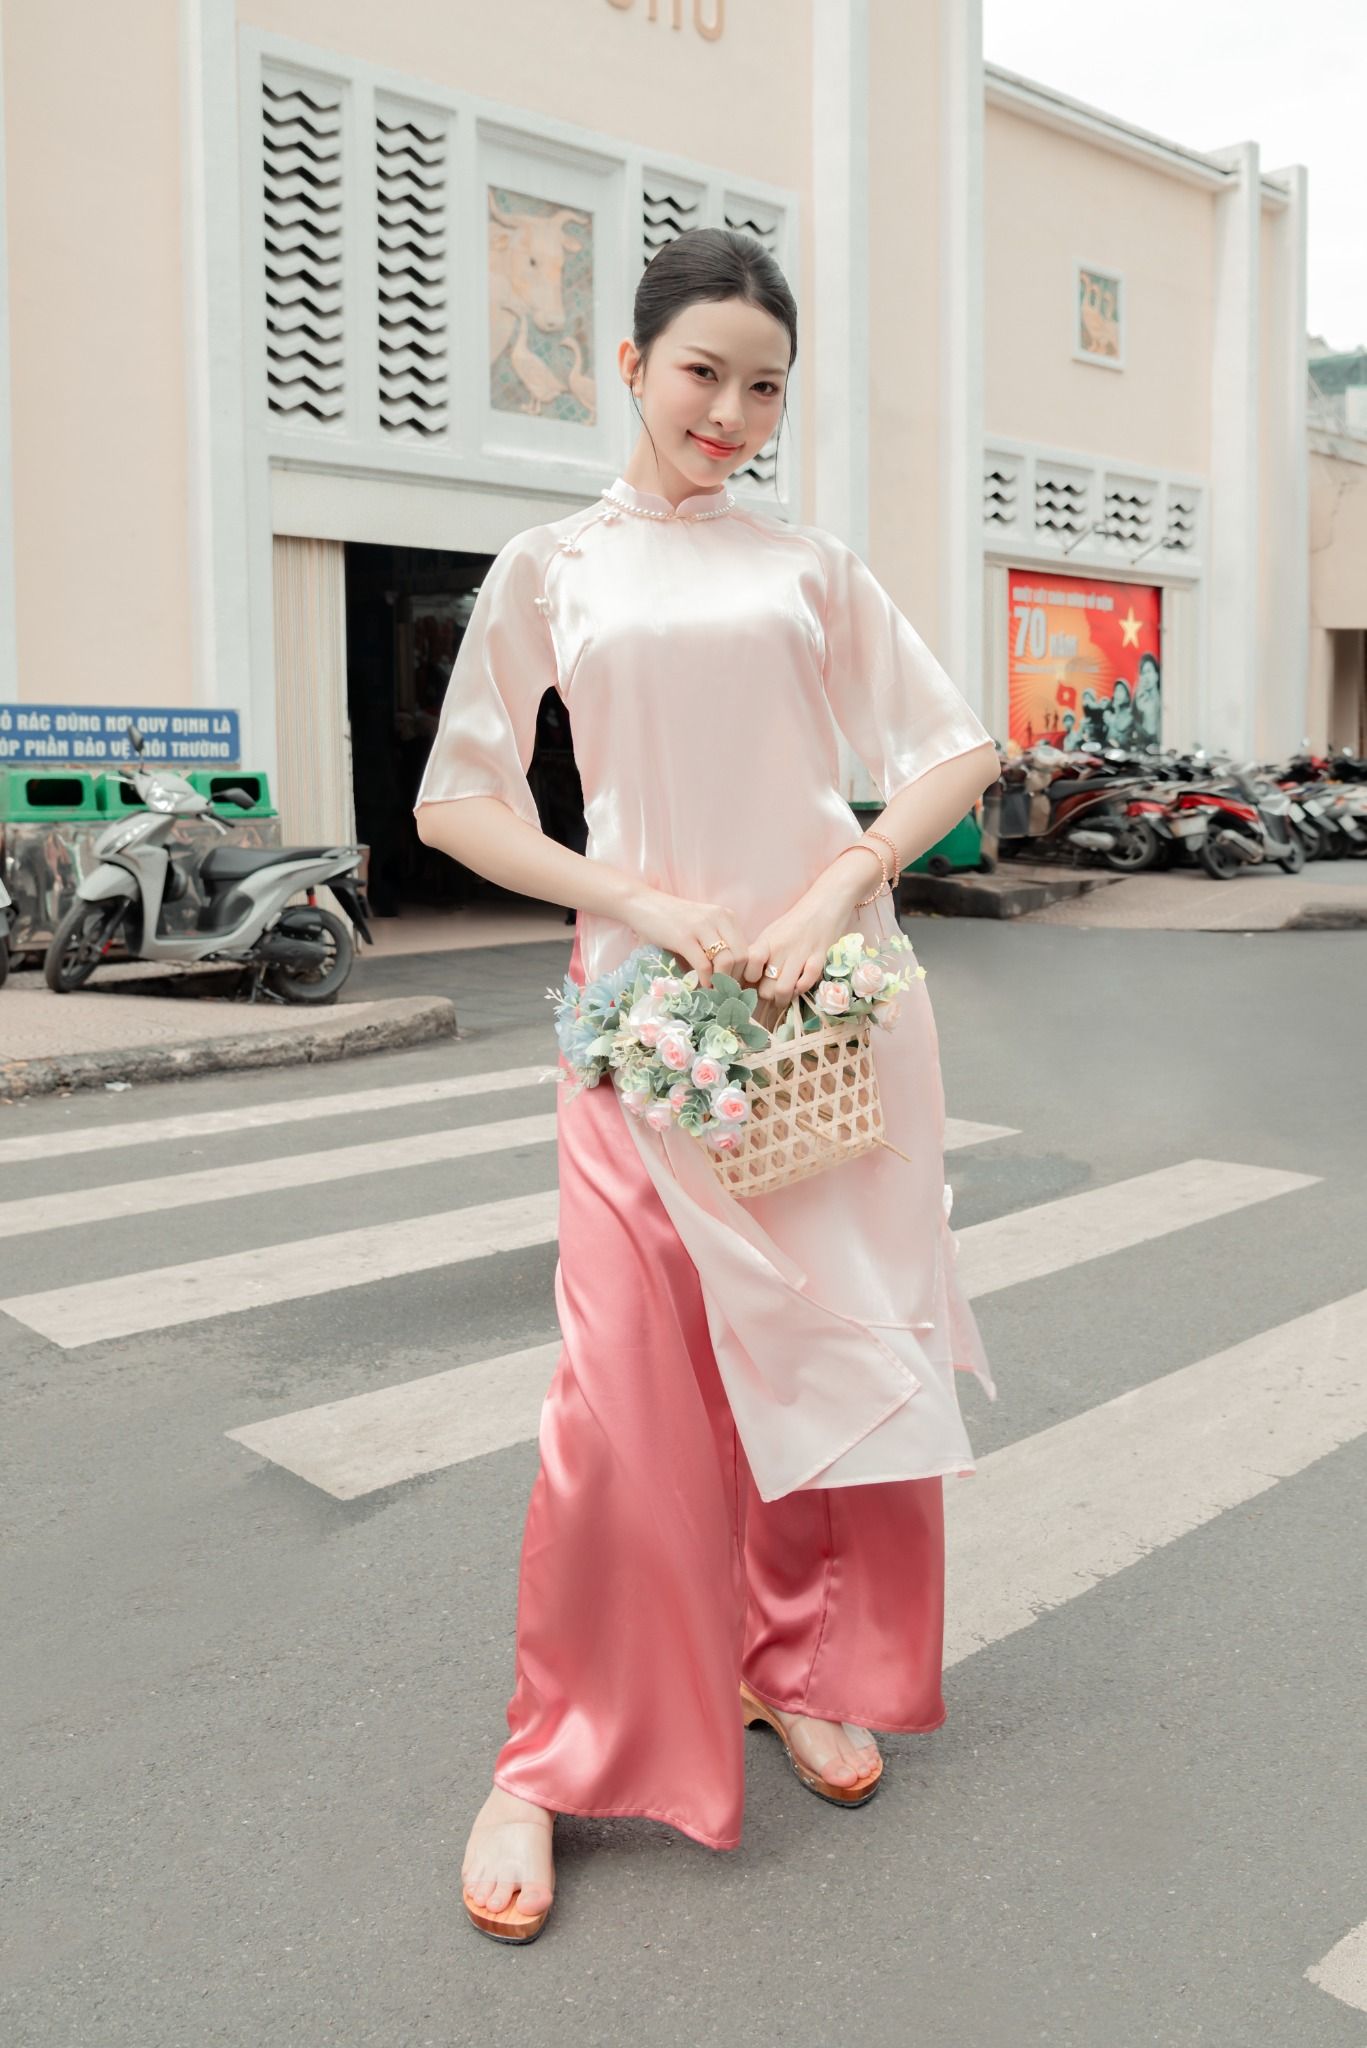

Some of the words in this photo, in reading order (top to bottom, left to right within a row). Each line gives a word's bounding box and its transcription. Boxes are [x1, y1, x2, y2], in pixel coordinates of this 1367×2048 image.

[1013, 607, 1047, 659] 70
[0, 709, 12, 731] Ỏ
[16, 711, 51, 731] RÁC
[137, 715, 168, 733] QUY
[171, 717, 209, 737] ĐỊNH
[213, 715, 231, 734] LÀ
[0, 737, 20, 757] ÓP
[24, 735, 69, 757] PHẦN
[73, 736, 106, 757] BẢO
[110, 738, 130, 760] VỆ
